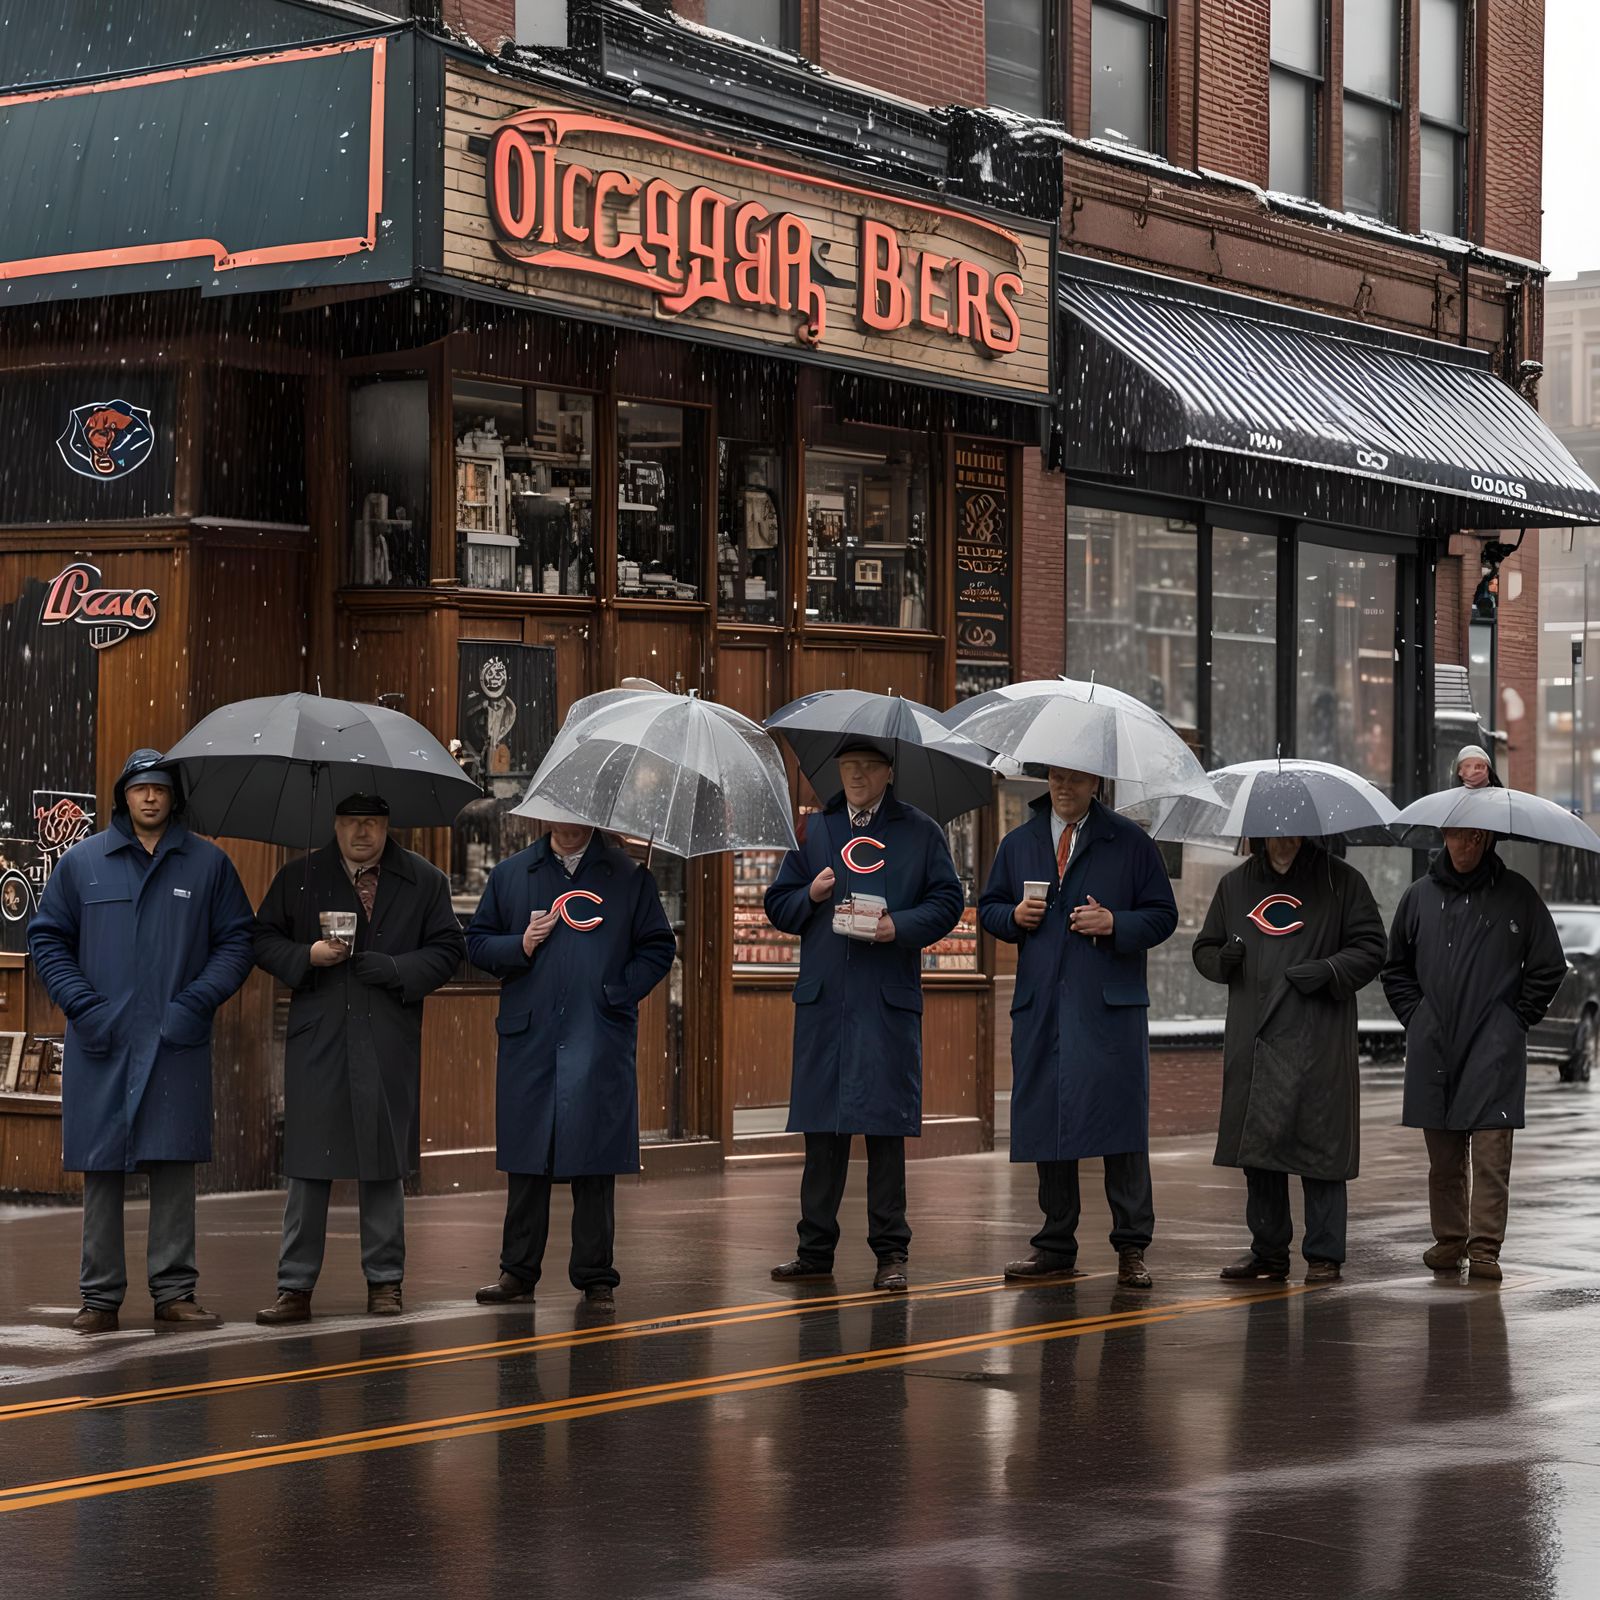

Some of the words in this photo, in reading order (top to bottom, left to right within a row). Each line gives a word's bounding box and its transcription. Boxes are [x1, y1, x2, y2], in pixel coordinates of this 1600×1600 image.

[858, 217, 1026, 355] BERS
[840, 835, 886, 874] C
[550, 889, 604, 932] C
[1246, 893, 1304, 936] C
